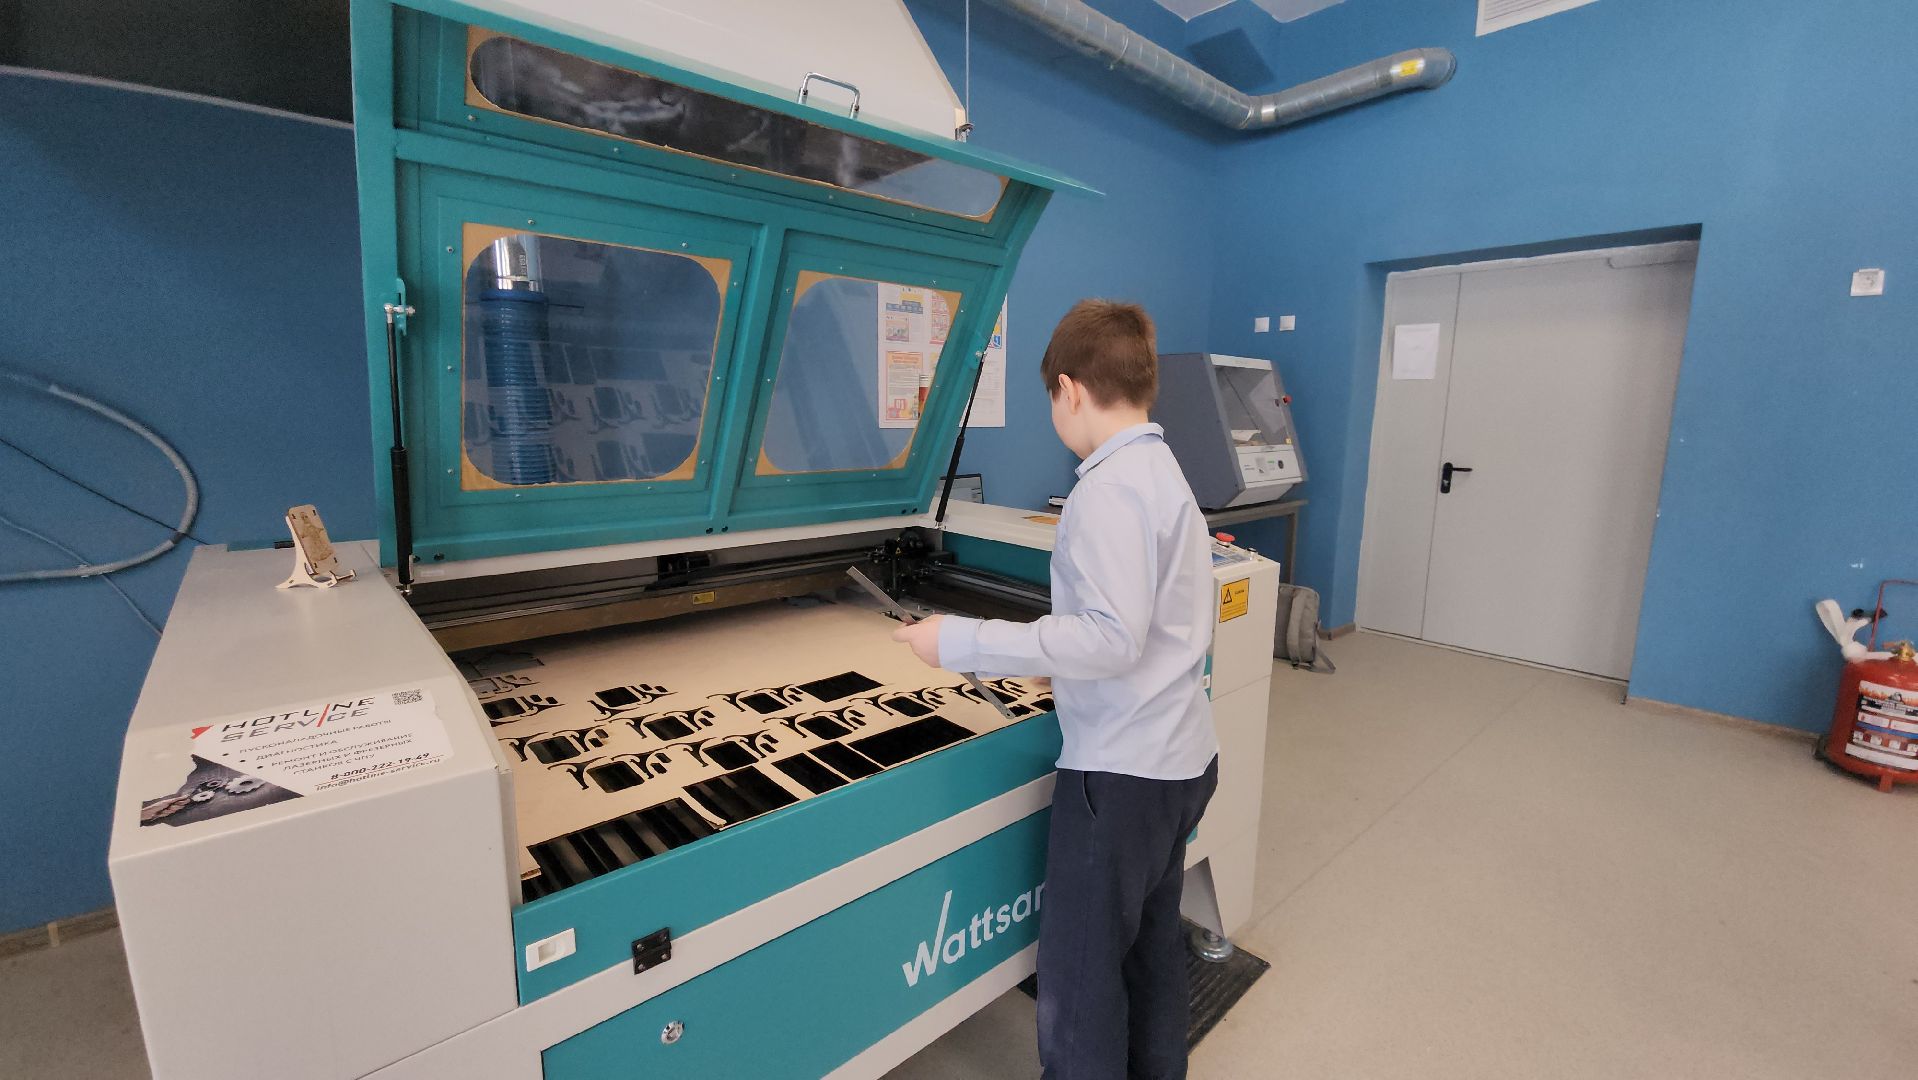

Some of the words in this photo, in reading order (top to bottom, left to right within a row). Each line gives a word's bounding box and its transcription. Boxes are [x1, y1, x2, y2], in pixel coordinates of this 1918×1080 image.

[221, 696, 376, 732] HOTLINE
[220, 704, 370, 743] SERVICE
[352, 719, 392, 731] РАБОТЫ
[256, 740, 338, 761] ДИАГНОСТИКА
[271, 753, 317, 767] РЕМОНТ
[283, 755, 342, 771] ЛАЗЕРНЫХ
